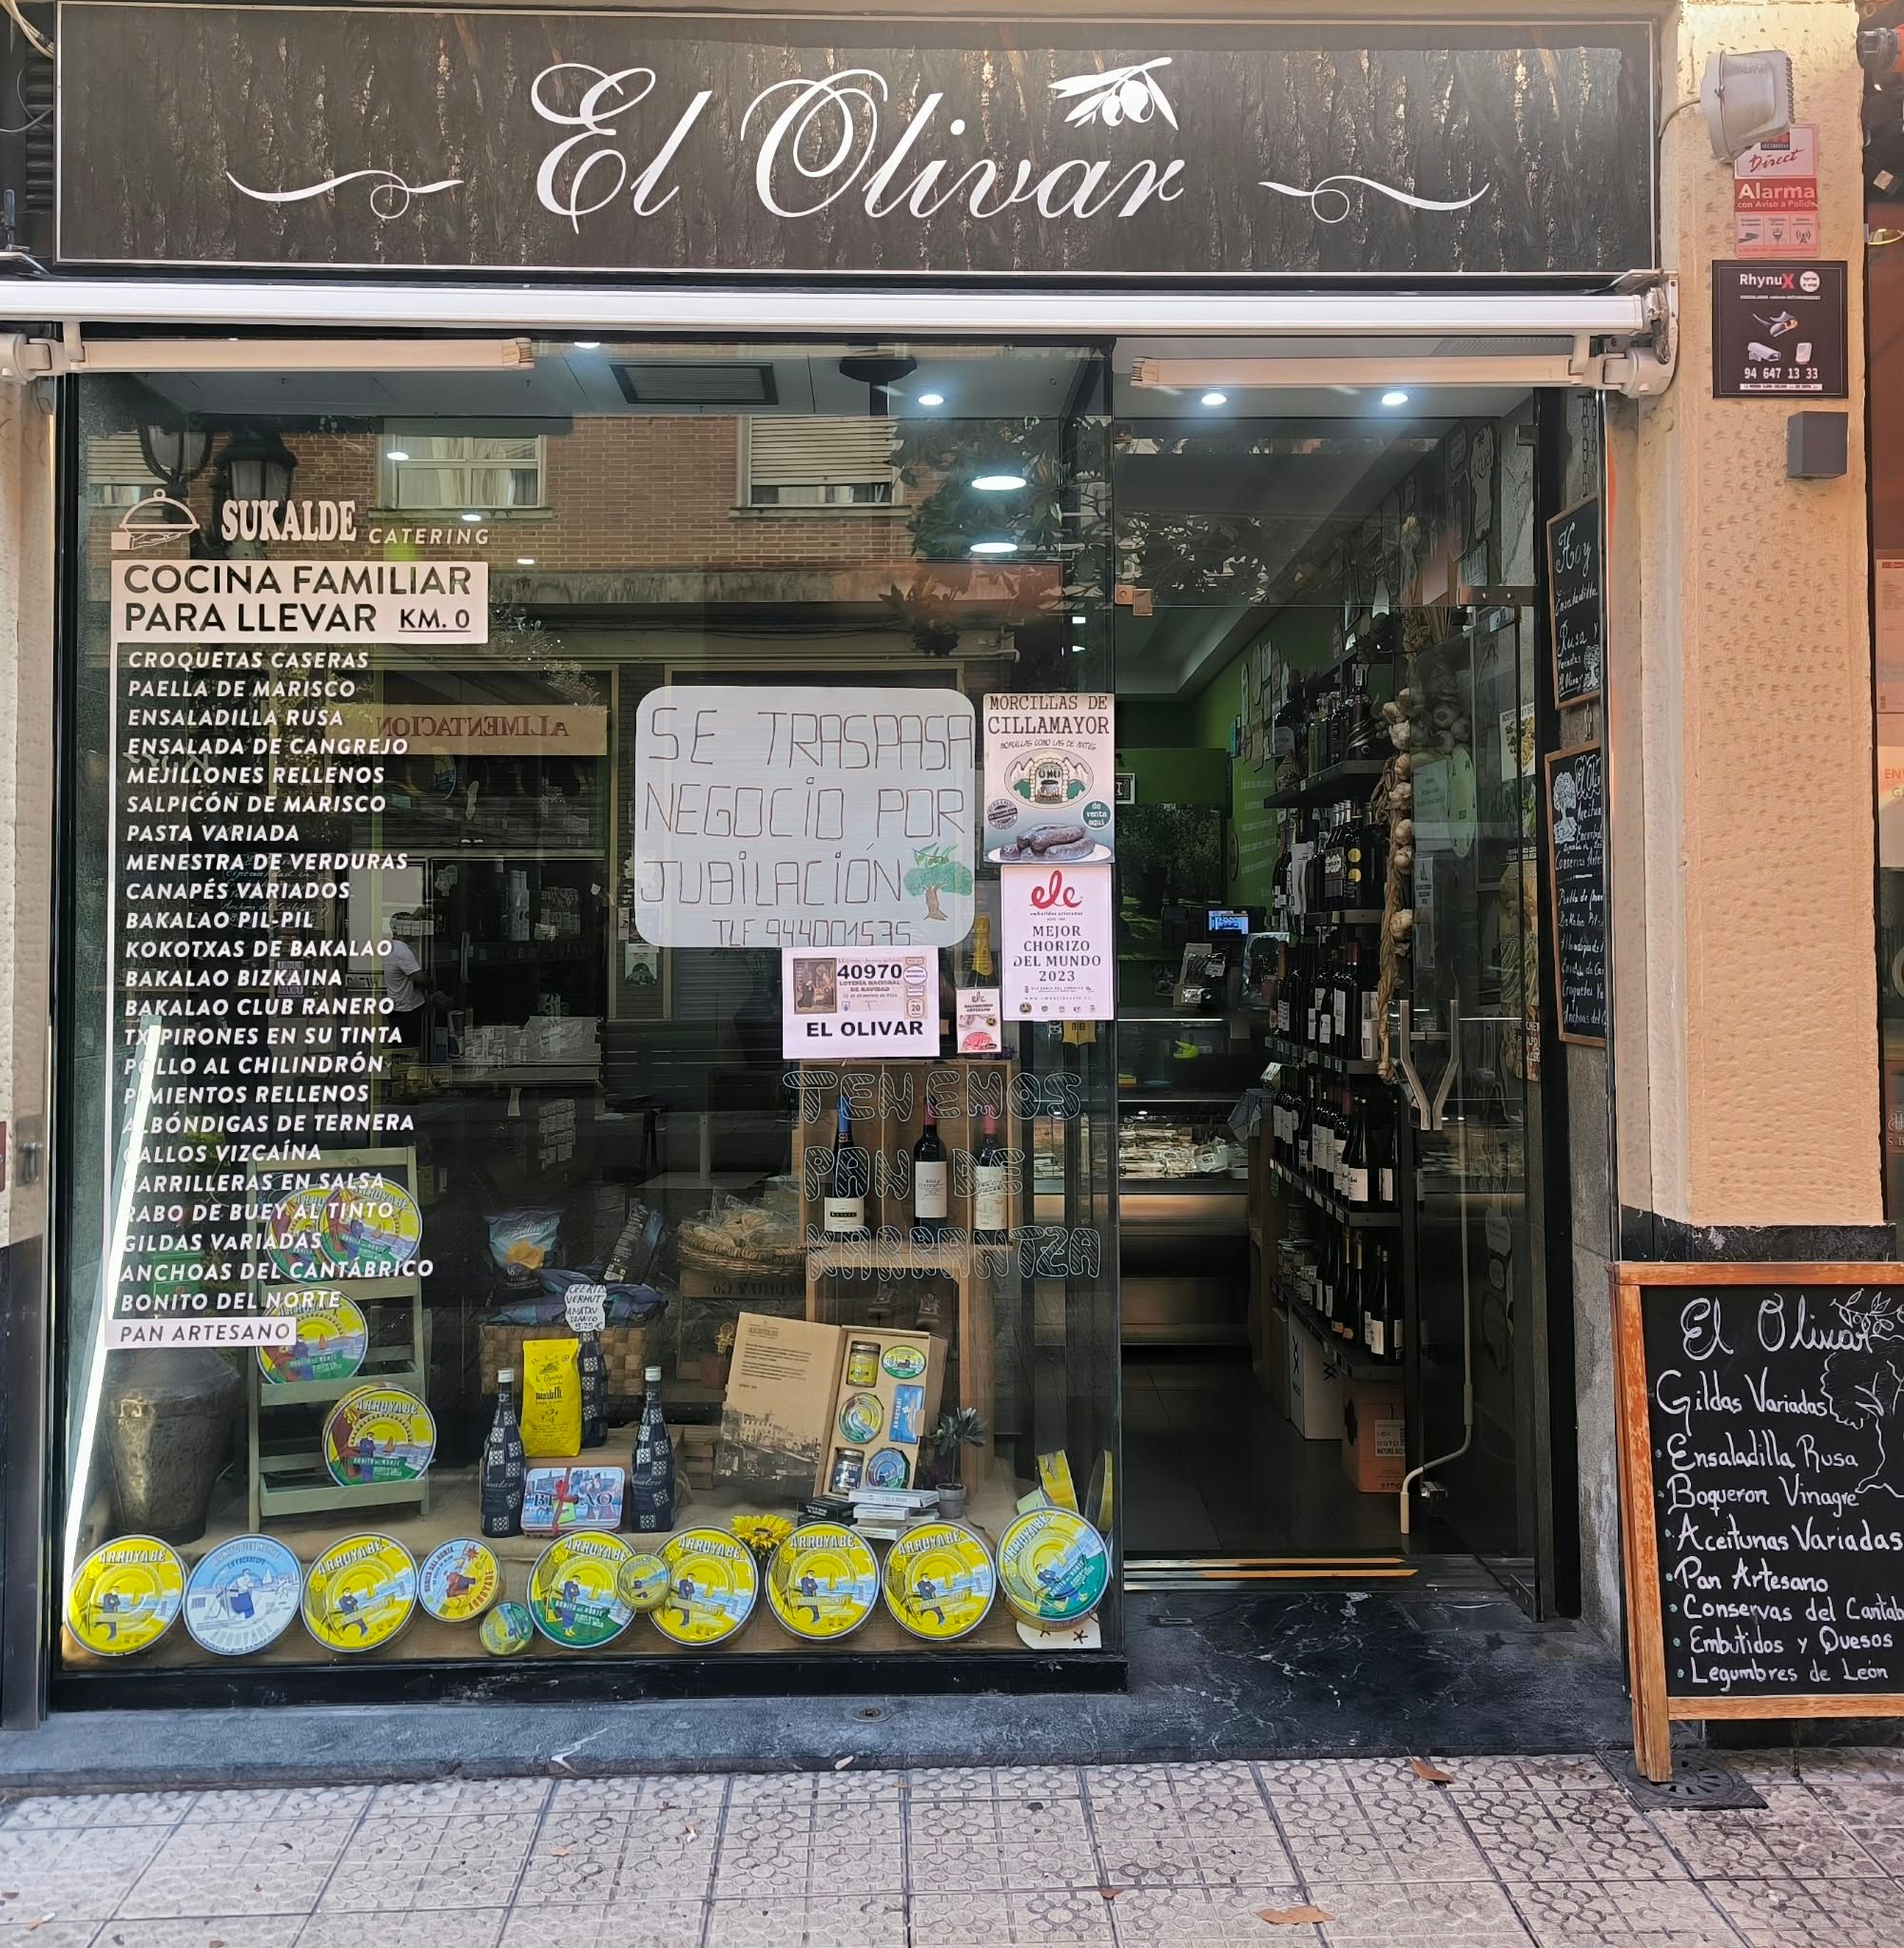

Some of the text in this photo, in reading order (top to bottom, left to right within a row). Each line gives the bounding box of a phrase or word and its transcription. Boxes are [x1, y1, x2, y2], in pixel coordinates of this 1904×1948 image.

[531, 62, 1185, 235] El Olivar
[1749, 148, 1803, 172] Direct
[1738, 183, 1816, 199] Alarma
[1740, 273, 1795, 289] RhynuX
[1744, 368, 1817, 379] 94 647 13 33
[222, 500, 489, 545] SUKALDE CATERING
[1556, 523, 1591, 576] Hoy
[124, 564, 471, 595] COCINA FAMILIAR
[126, 603, 470, 633] PARA LLEVAR KM. 0
[128, 652, 369, 672] CROQUETAS CASERAS
[128, 681, 355, 697] PAELLA DE MARISCO
[989, 695, 1107, 710] MORCILLAS DE
[128, 710, 342, 726] ENSALADILLA RUSA
[988, 716, 1110, 734] CILLAMAYOR
[127, 738, 407, 755] ENSALADA DE CANGREJO
[650, 707, 973, 770] SE TRASPASA
[126, 768, 384, 784] MEJILLONES RELLENOS
[1885, 769, 1904, 779] EN
[126, 794, 385, 813] SALPICÓN DE MARISCO
[877, 788, 965, 838] POR
[126, 825, 299, 842] PASTA VARIADA
[126, 853, 407, 870] MENESTRA DE VERDURAS
[126, 880, 227, 900] CANAPÉS
[238, 883, 350, 899] VARIADOS
[126, 912, 313, 929] BAKALAO PIL-PIL
[712, 918, 912, 947] TLF 944001575
[1033, 925, 1080, 938] MEJOR
[126, 941, 392, 958] KOKOTXAS DE BAKALAO
[1023, 941, 1090, 951] CHORIZO
[1013, 956, 1101, 966] DEL MUNDO
[126, 970, 341, 987] BAKALAO BIZKAINA
[837, 964, 903, 979] 40970
[1039, 971, 1075, 982] 2023
[126, 998, 394, 1017] BAKALAO CLUB RANERO
[125, 1027, 401, 1045] TXPIRONES EN SU TINTA
[806, 1021, 923, 1037] EL OLIVAR
[204, 1058, 230, 1074] AL
[240, 1052, 382, 1074] CHILINDRÓN
[124, 1085, 369, 1104] PMIENTOS RELLENOS
[123, 1112, 414, 1134] ABÓNDIGAS DE TERNERA
[216, 1140, 321, 1161] VIZCAÍNA
[124, 1172, 384, 1192] ARRILLERAS EN SALSA
[805, 1146, 909, 1201] PAN
[192, 1203, 221, 1220] DE
[229, 1203, 286, 1220] BUEY
[293, 1203, 320, 1219] AL
[328, 1202, 393, 1218] TINTO
[124, 1233, 322, 1252] GILDAS VARIADAS
[121, 1256, 434, 1281] ANCHOAS DEL CANTÁBRICO
[121, 1291, 341, 1312] BONITO DEL NORTE
[121, 1323, 290, 1342] PAN ARTESANO
[1680, 1293, 1873, 1361] El Olivar
[1656, 1367, 1827, 1436] Gildas Variadas
[1667, 1430, 1858, 1472] Ensaladilla Rusa
[1666, 1472, 1859, 1517] Boqueron Vinagre
[1677, 1512, 1903, 1551] Aceitunas Variadas
[564, 1537, 630, 1562] ARROYABE
[678, 1536, 741, 1559] ARROYABE
[790, 1535, 856, 1549] ARROYABE
[898, 1532, 962, 1555] ARROYABE
[98, 1549, 168, 1564] ARROYABE
[318, 1541, 384, 1575] ARROYABE
[1674, 1555, 1829, 1593] Pan Artesano
[1683, 1593, 1793, 1622] Conservas
[1805, 1597, 1835, 1622] del
[1689, 1625, 1784, 1655] Embutidos
[1819, 1625, 1894, 1654] Quesos
[1690, 1657, 1797, 1692] Legumbres
[1809, 1659, 1831, 1682] de
